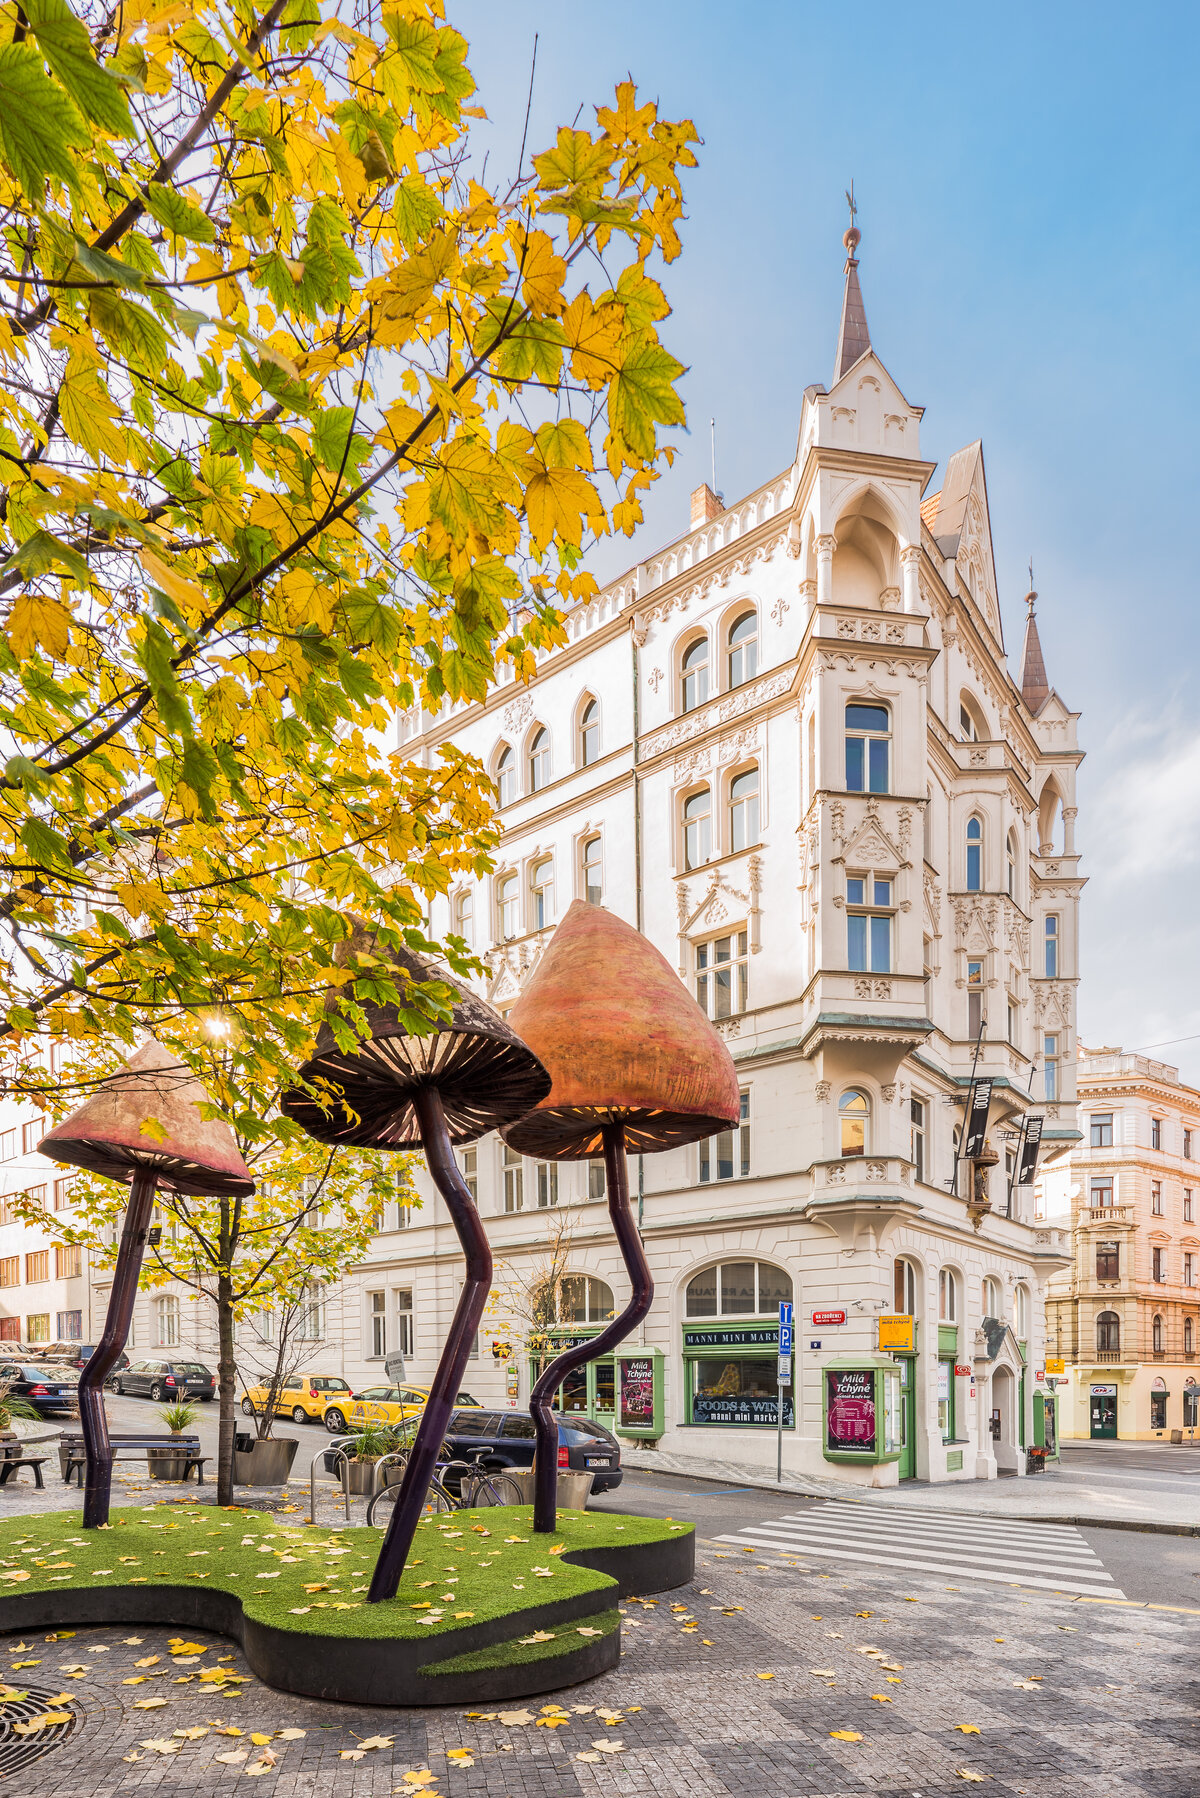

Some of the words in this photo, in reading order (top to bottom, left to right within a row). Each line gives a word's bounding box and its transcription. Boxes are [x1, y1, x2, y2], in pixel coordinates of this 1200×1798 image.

[687, 1334, 717, 1343] MANNI
[722, 1333, 745, 1342] MINI
[750, 1332, 779, 1342] MARK
[631, 1362, 648, 1370] Milá
[842, 1374, 865, 1383] Milá
[836, 1384, 871, 1394] Tchýně
[697, 1401, 738, 1412] FOODS
[739, 1401, 750, 1412] &
[751, 1401, 789, 1412] WINE
[711, 1413, 731, 1421] manni
[735, 1413, 750, 1421] mini
